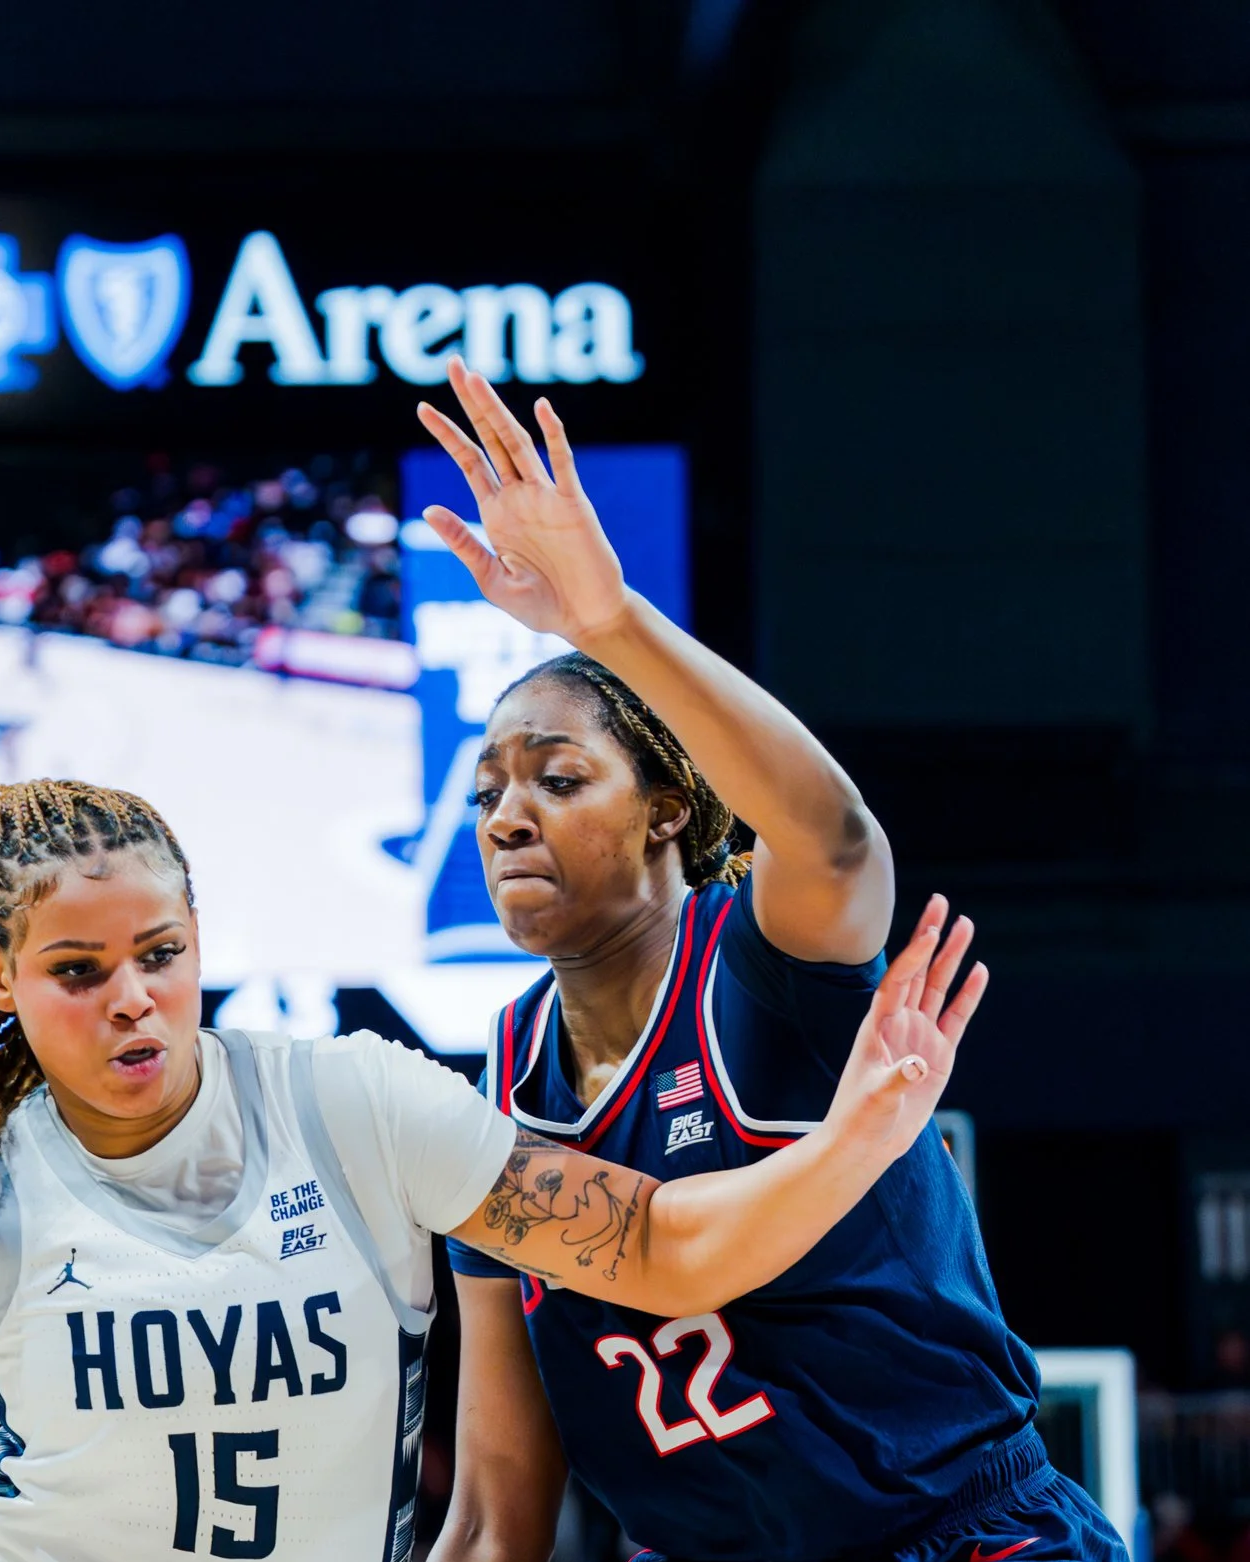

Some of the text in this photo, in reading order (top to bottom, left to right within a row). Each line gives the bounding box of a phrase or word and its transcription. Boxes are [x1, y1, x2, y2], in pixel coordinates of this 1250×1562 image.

[188, 229, 645, 386] Arena
[666, 1121, 715, 1147] EAST
[670, 1110, 703, 1133] BIG
[270, 1180, 319, 1208] BE THE
[270, 1194, 325, 1222] CHANGE
[280, 1233, 328, 1254] EAST
[282, 1224, 315, 1242] BIG
[66, 1290, 348, 1411] HOYAS
[594, 1310, 776, 1458] 22
[168, 1428, 280, 1560] 15
